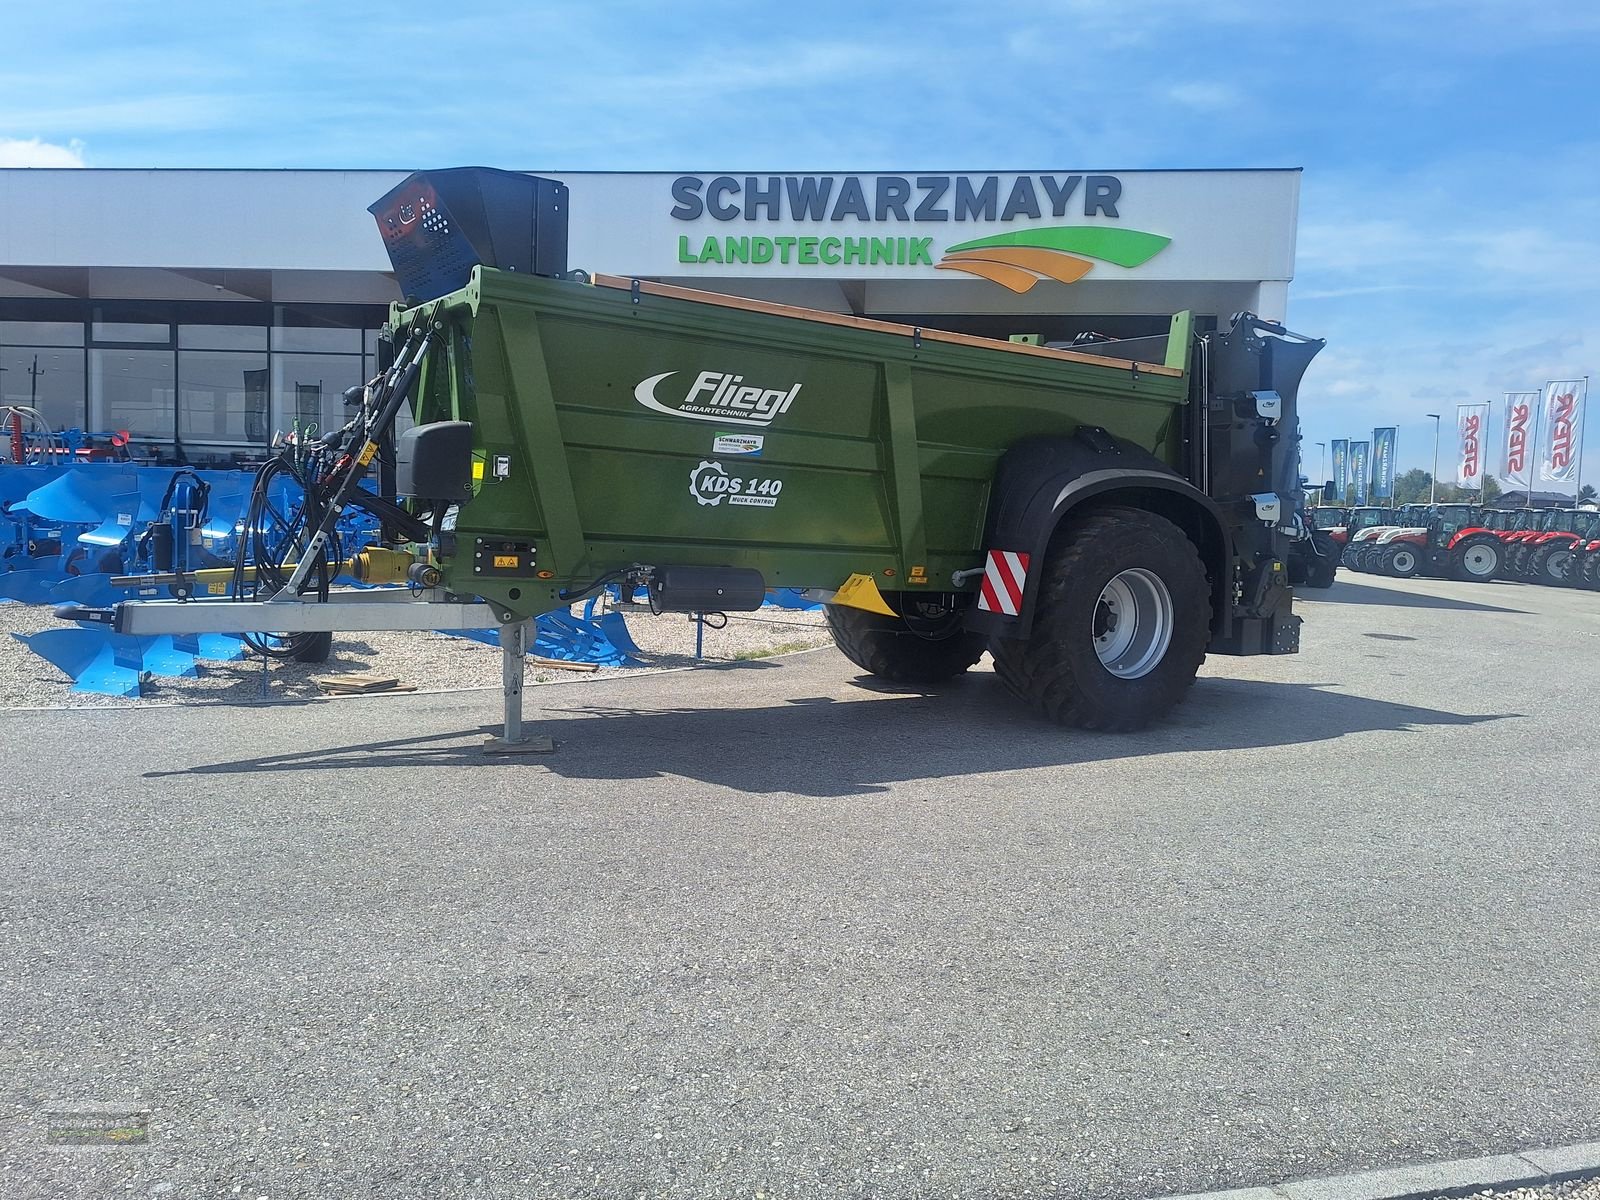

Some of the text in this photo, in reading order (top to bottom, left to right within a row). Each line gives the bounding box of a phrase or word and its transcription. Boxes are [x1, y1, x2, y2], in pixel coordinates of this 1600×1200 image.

[670, 175, 1123, 222] SCHWARZMAYR
[678, 235, 934, 266] LANDTECHNIK
[684, 370, 803, 420] Fliegl
[678, 404, 751, 418] AGRARTECHNIK
[700, 475, 783, 496] KDS 140
[731, 496, 775, 505] MUCK CONTROL
